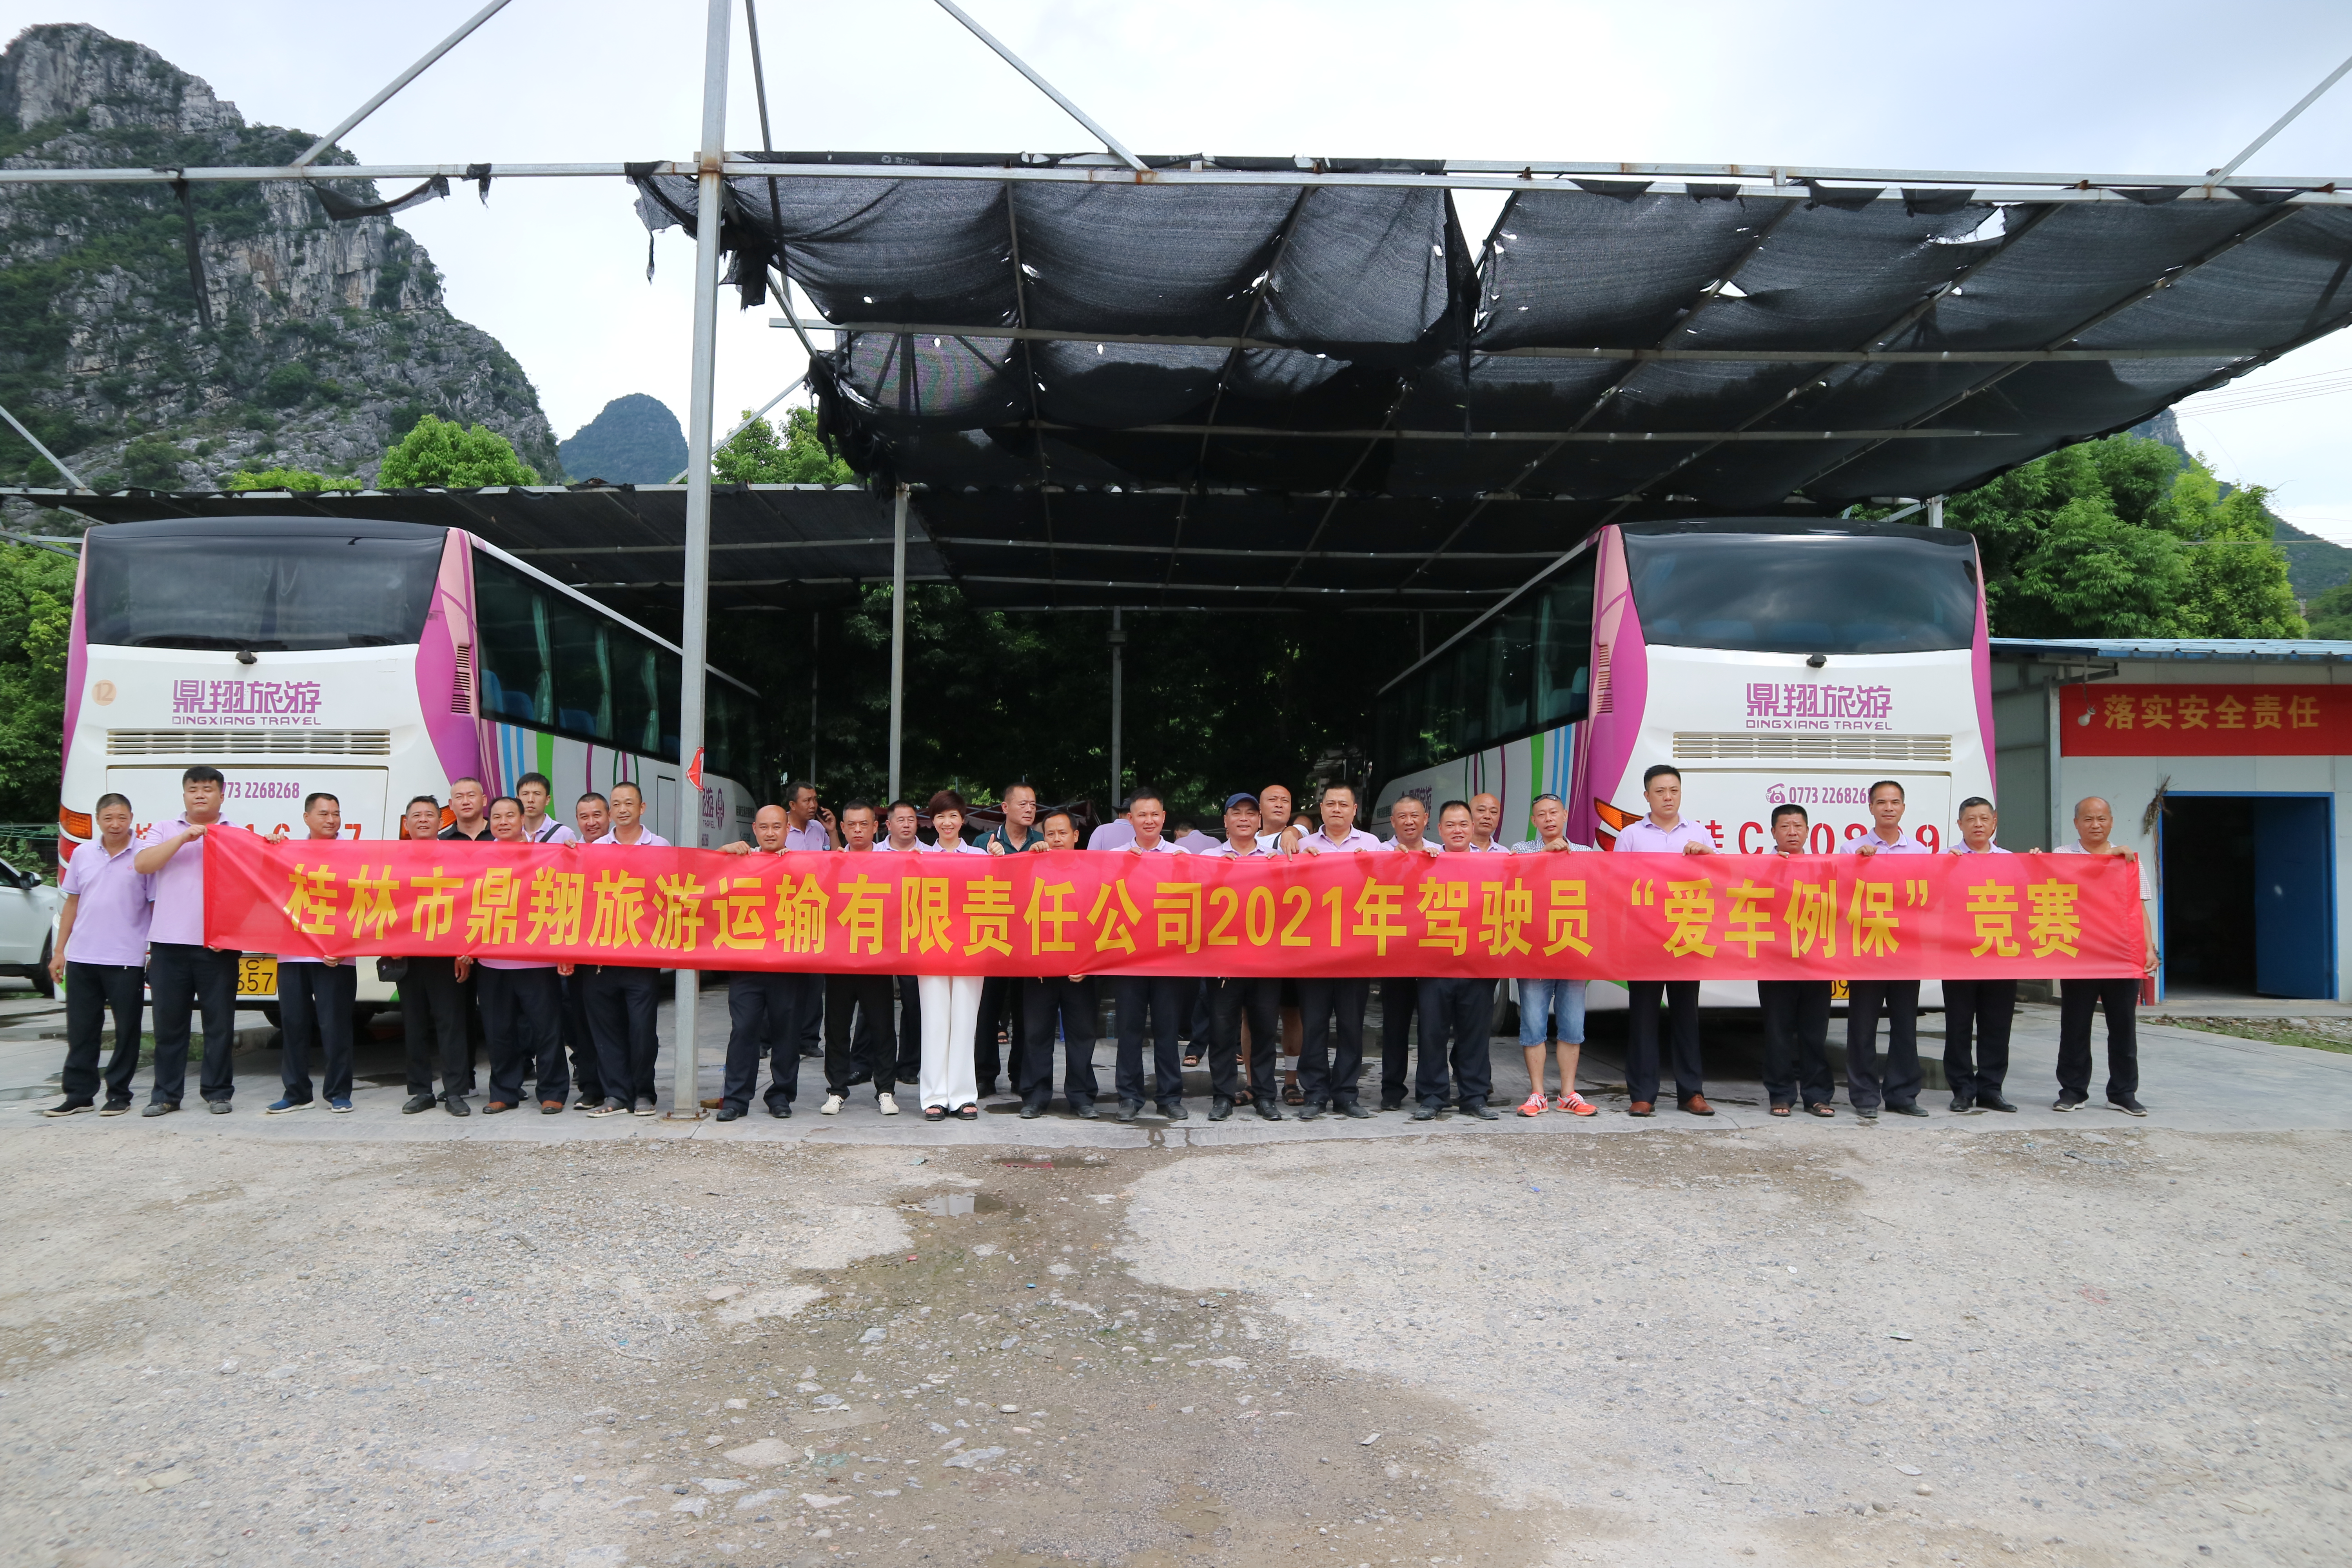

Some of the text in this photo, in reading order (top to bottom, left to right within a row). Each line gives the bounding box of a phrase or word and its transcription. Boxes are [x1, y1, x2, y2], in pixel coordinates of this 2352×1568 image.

[95, 682, 113, 701] 12
[173, 680, 322, 713] 鼎翔旅游
[1746, 683, 1893, 719] 鼎翔旅游
[172, 716, 321, 726] DINGXIANG TRAVEL
[2103, 694, 2320, 730] 落实安全责任
[1746, 719, 1893, 730] DINGXIANG TRAVEL
[245, 782, 300, 799] 2268268
[1789, 787, 1818, 804] 0773
